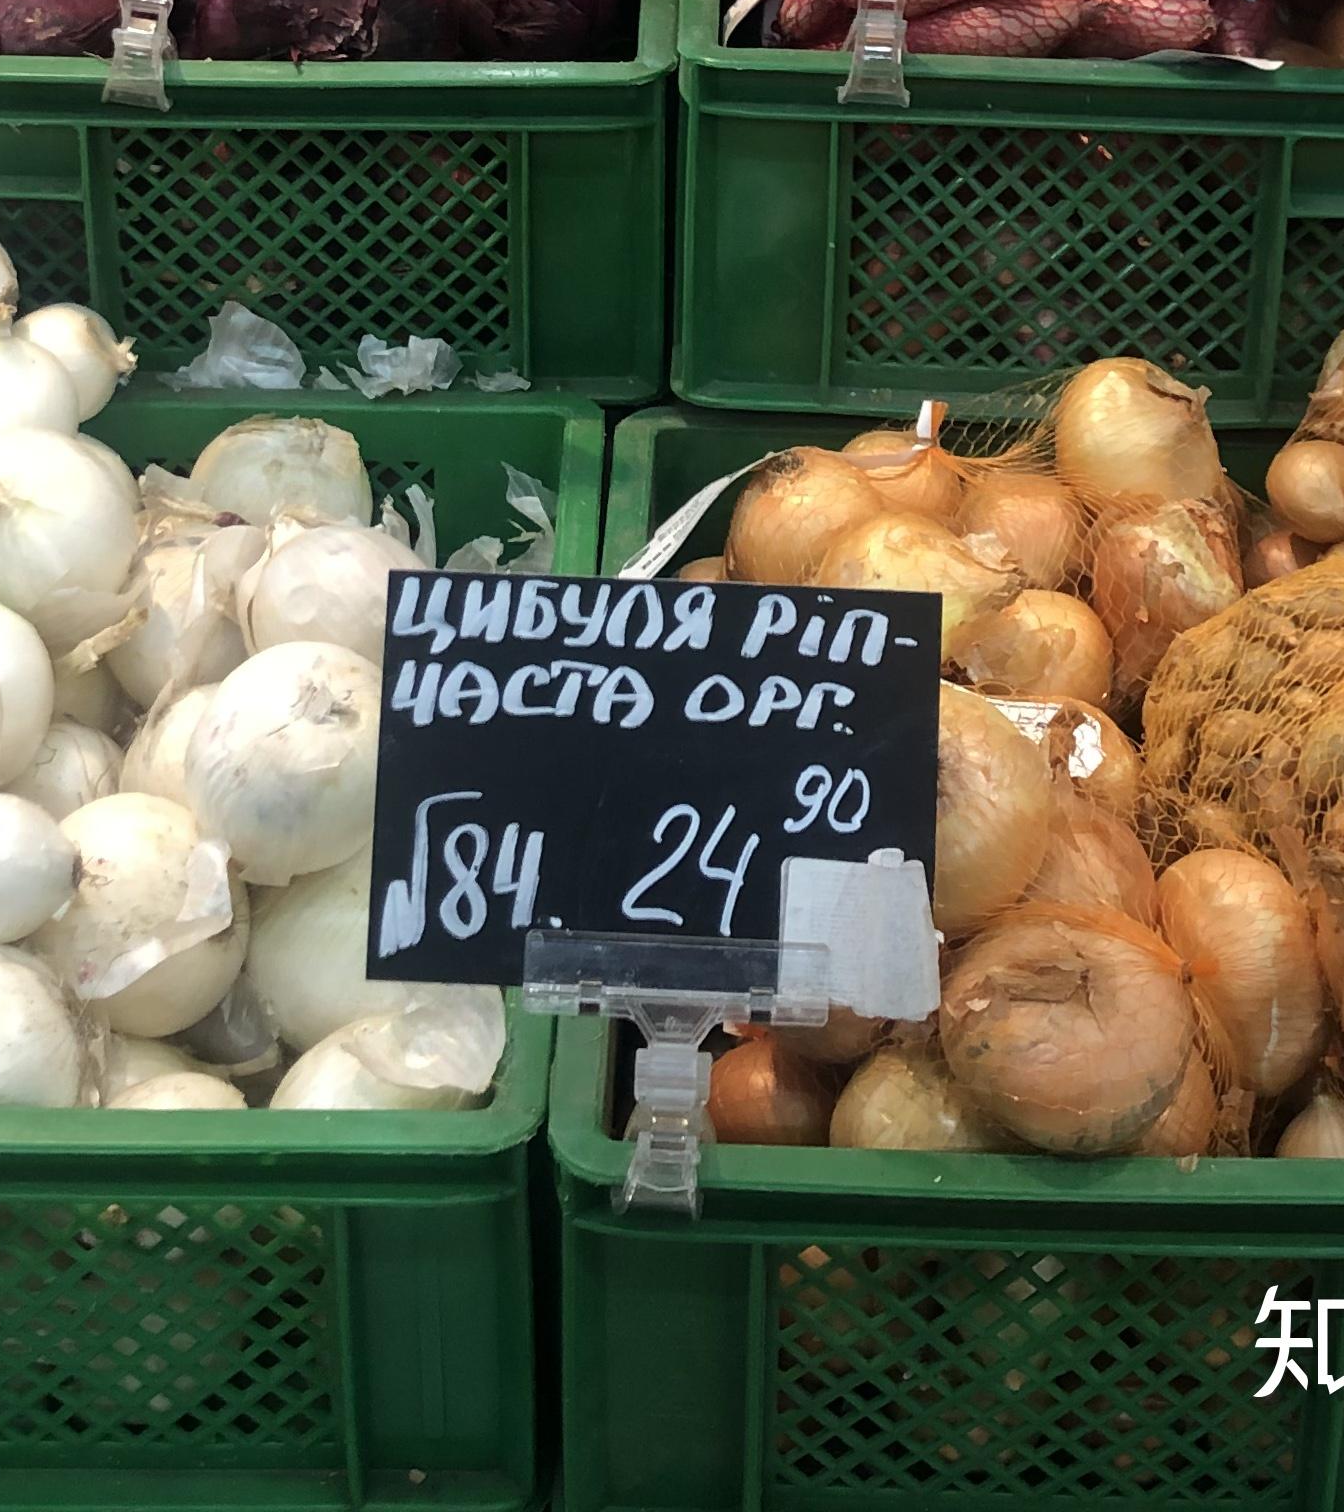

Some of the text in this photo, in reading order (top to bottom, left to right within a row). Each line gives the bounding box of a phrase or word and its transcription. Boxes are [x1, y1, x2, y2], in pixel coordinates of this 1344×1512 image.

[392, 577, 715, 653] ЦИБУЛЯ
[391, 659, 654, 729] ЧАСТА
[621, 804, 759, 937] 24
[783, 764, 871, 834] 90
